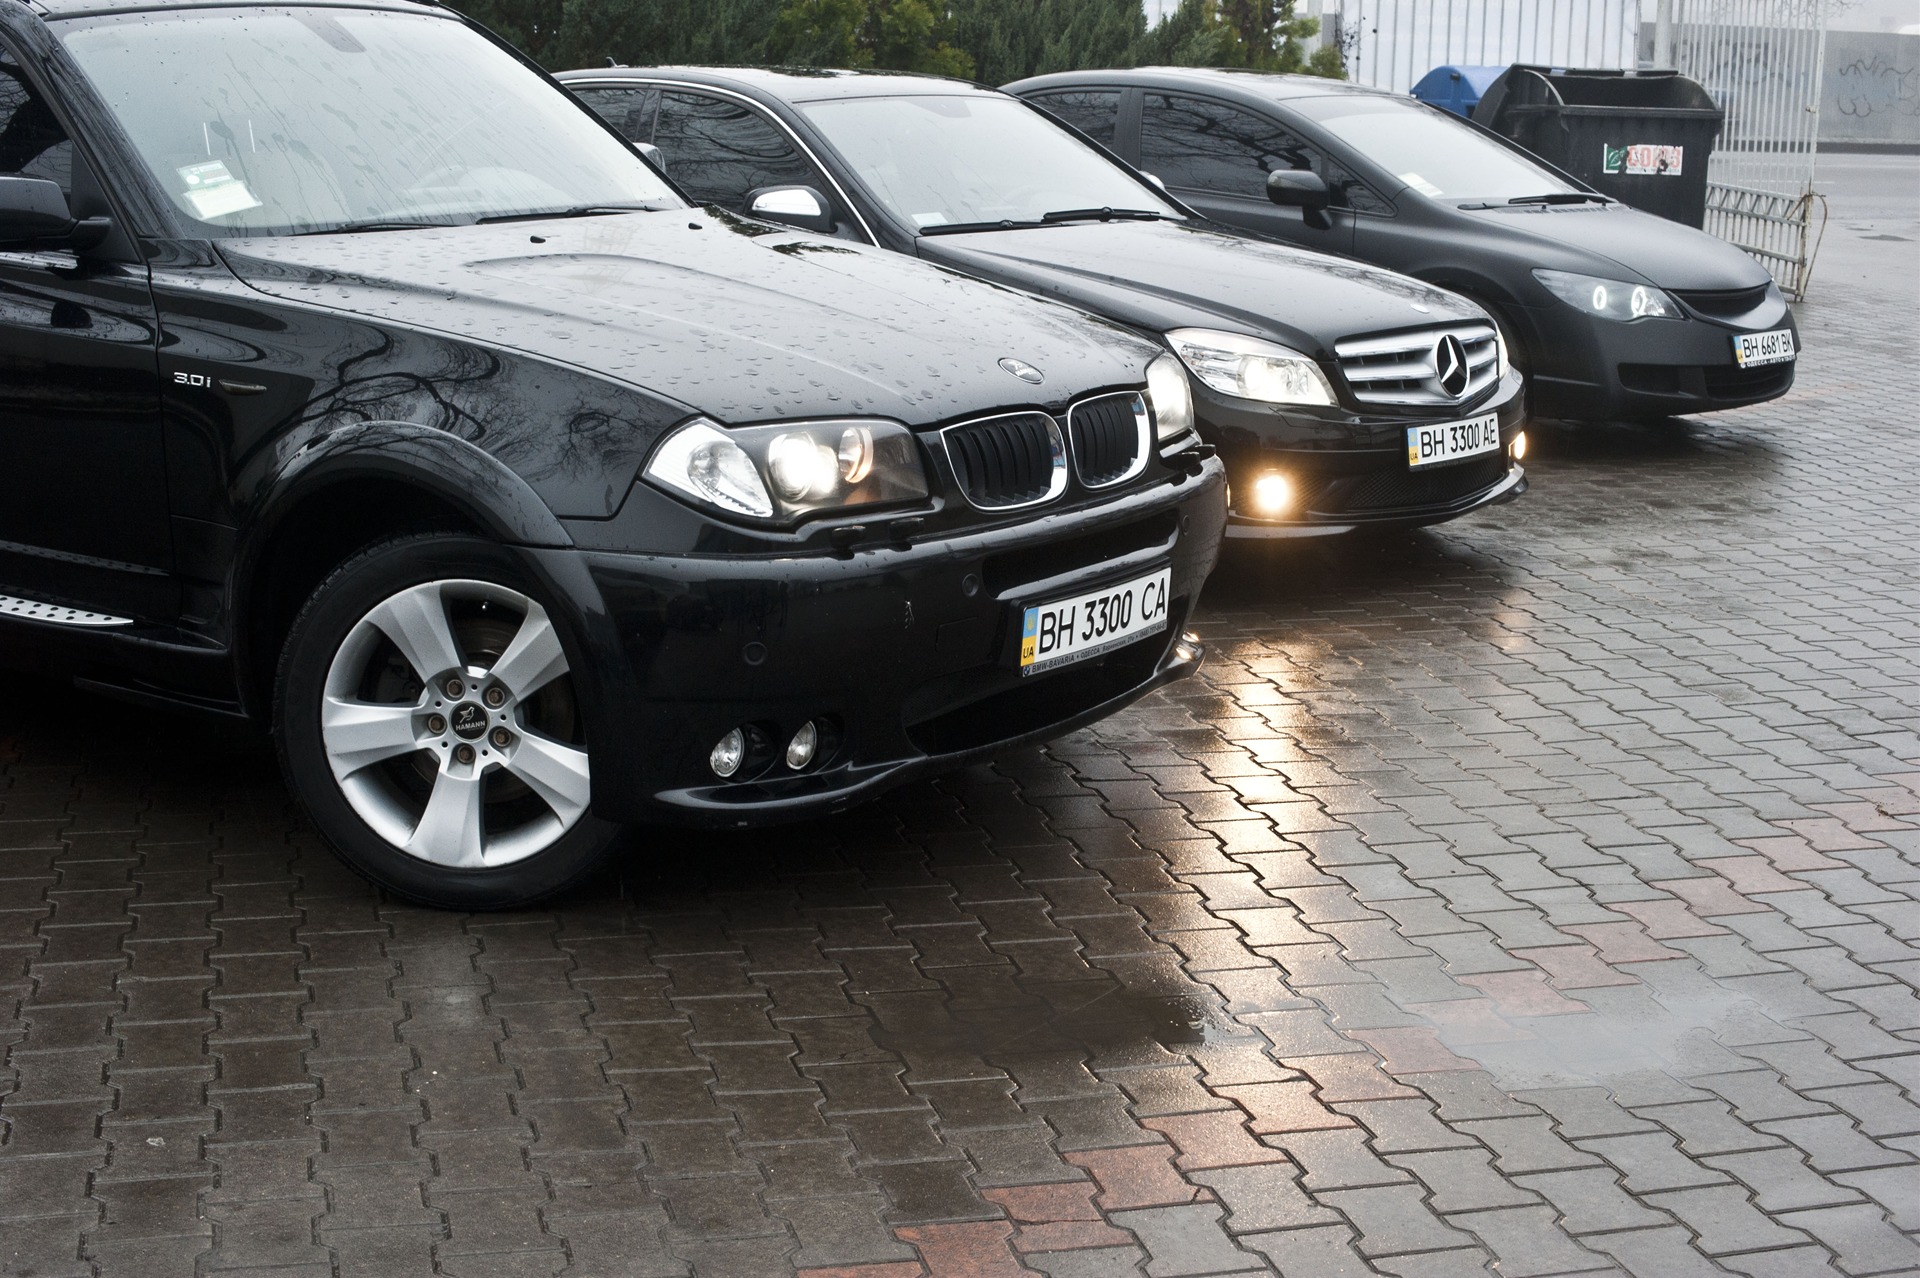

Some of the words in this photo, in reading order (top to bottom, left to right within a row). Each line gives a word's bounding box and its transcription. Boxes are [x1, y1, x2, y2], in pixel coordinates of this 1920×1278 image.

[1742, 337, 1760, 358] BH
[1761, 334, 1781, 356] 6681
[1780, 333, 1794, 353] BK
[173, 371, 212, 388] 3.0i
[1420, 428, 1446, 459] BH
[1449, 422, 1481, 454] 3300
[1482, 418, 1497, 447] AE
[1038, 605, 1077, 655] BH
[1081, 589, 1133, 642] 3300
[1141, 577, 1166, 621] CA
[1022, 645, 1035, 659] UA
[1031, 654, 1075, 674] BMW-BAVARIA
[455, 720, 486, 731] HAMANN
